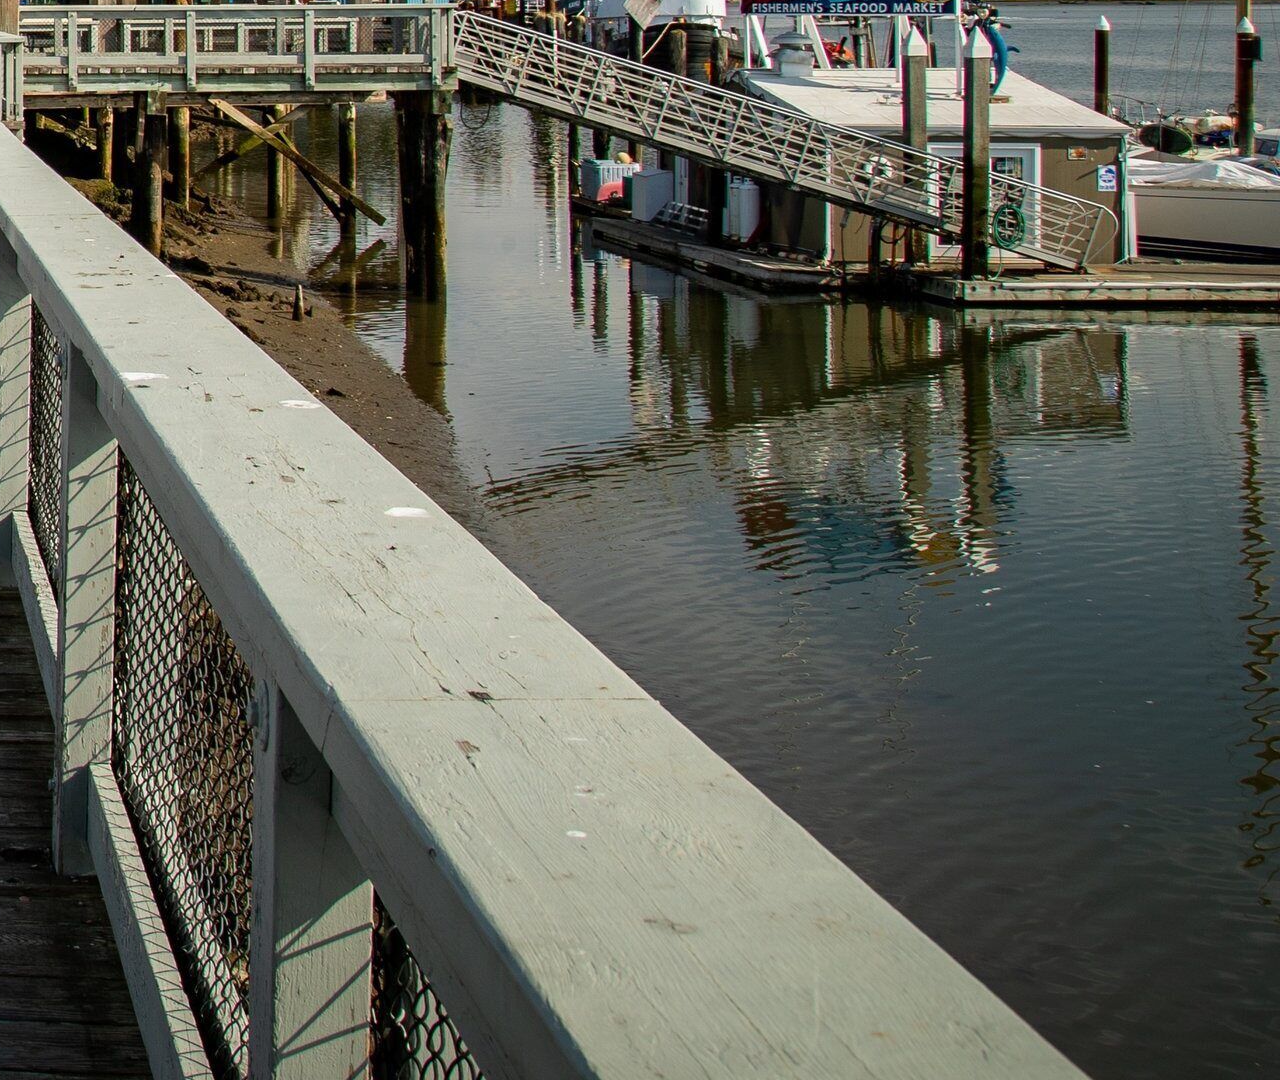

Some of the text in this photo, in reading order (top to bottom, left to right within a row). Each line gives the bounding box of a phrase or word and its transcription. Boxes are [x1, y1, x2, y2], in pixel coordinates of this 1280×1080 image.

[751, 2, 945, 14] FISHERMEN'S SEAFOOD MARKET
